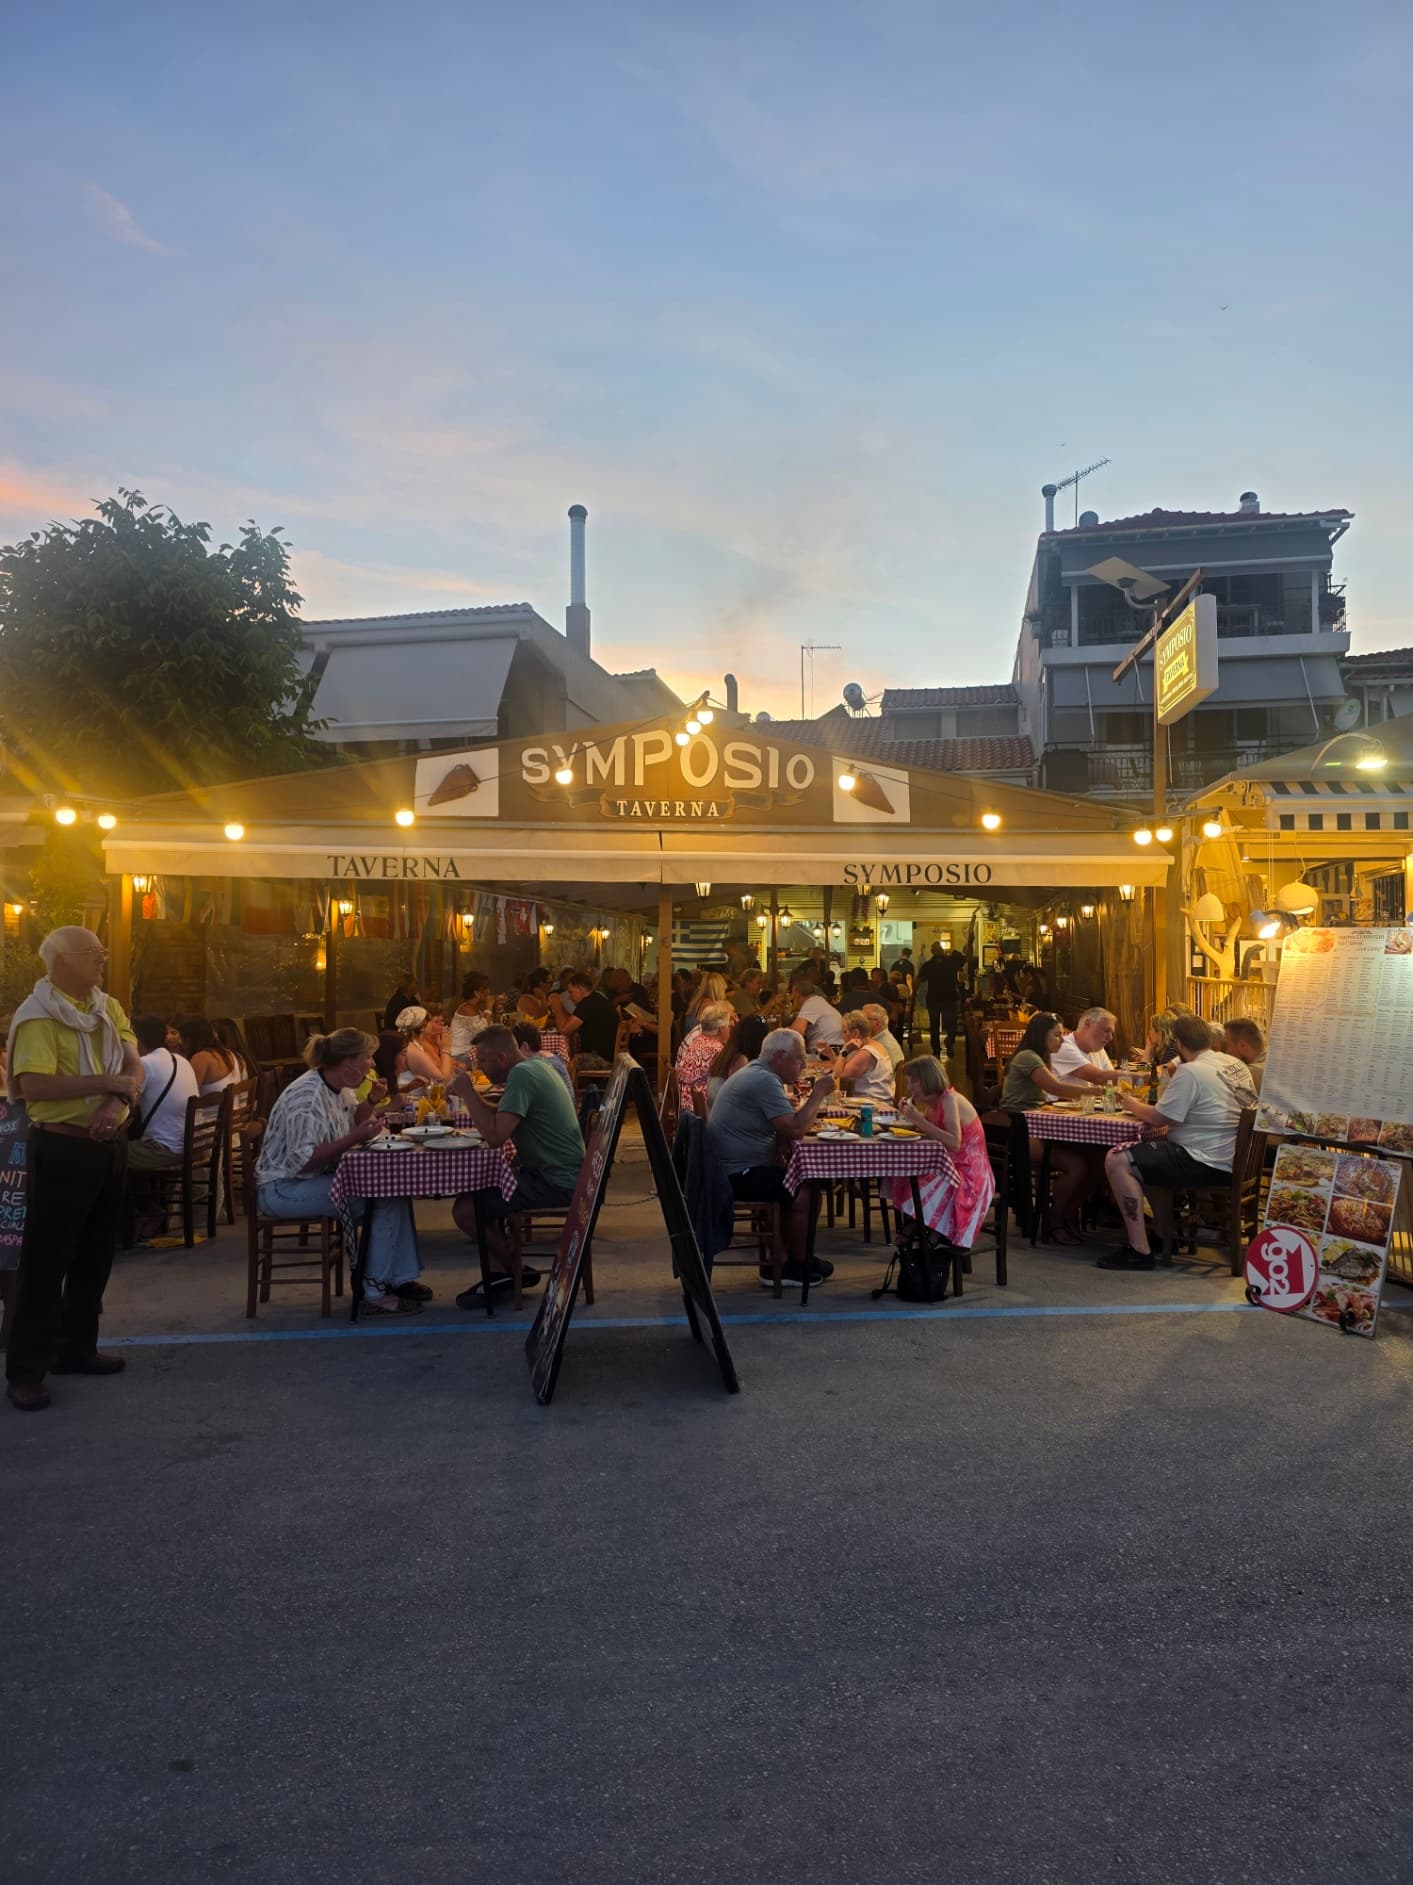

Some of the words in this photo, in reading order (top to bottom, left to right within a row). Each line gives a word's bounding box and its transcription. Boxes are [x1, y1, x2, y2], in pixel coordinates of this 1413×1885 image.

[521, 729, 815, 791] SYMPOSIO
[616, 799, 720, 818] TAVERNA
[327, 855, 461, 879] TAVERNA
[843, 863, 992, 884] SYMPOSIO
